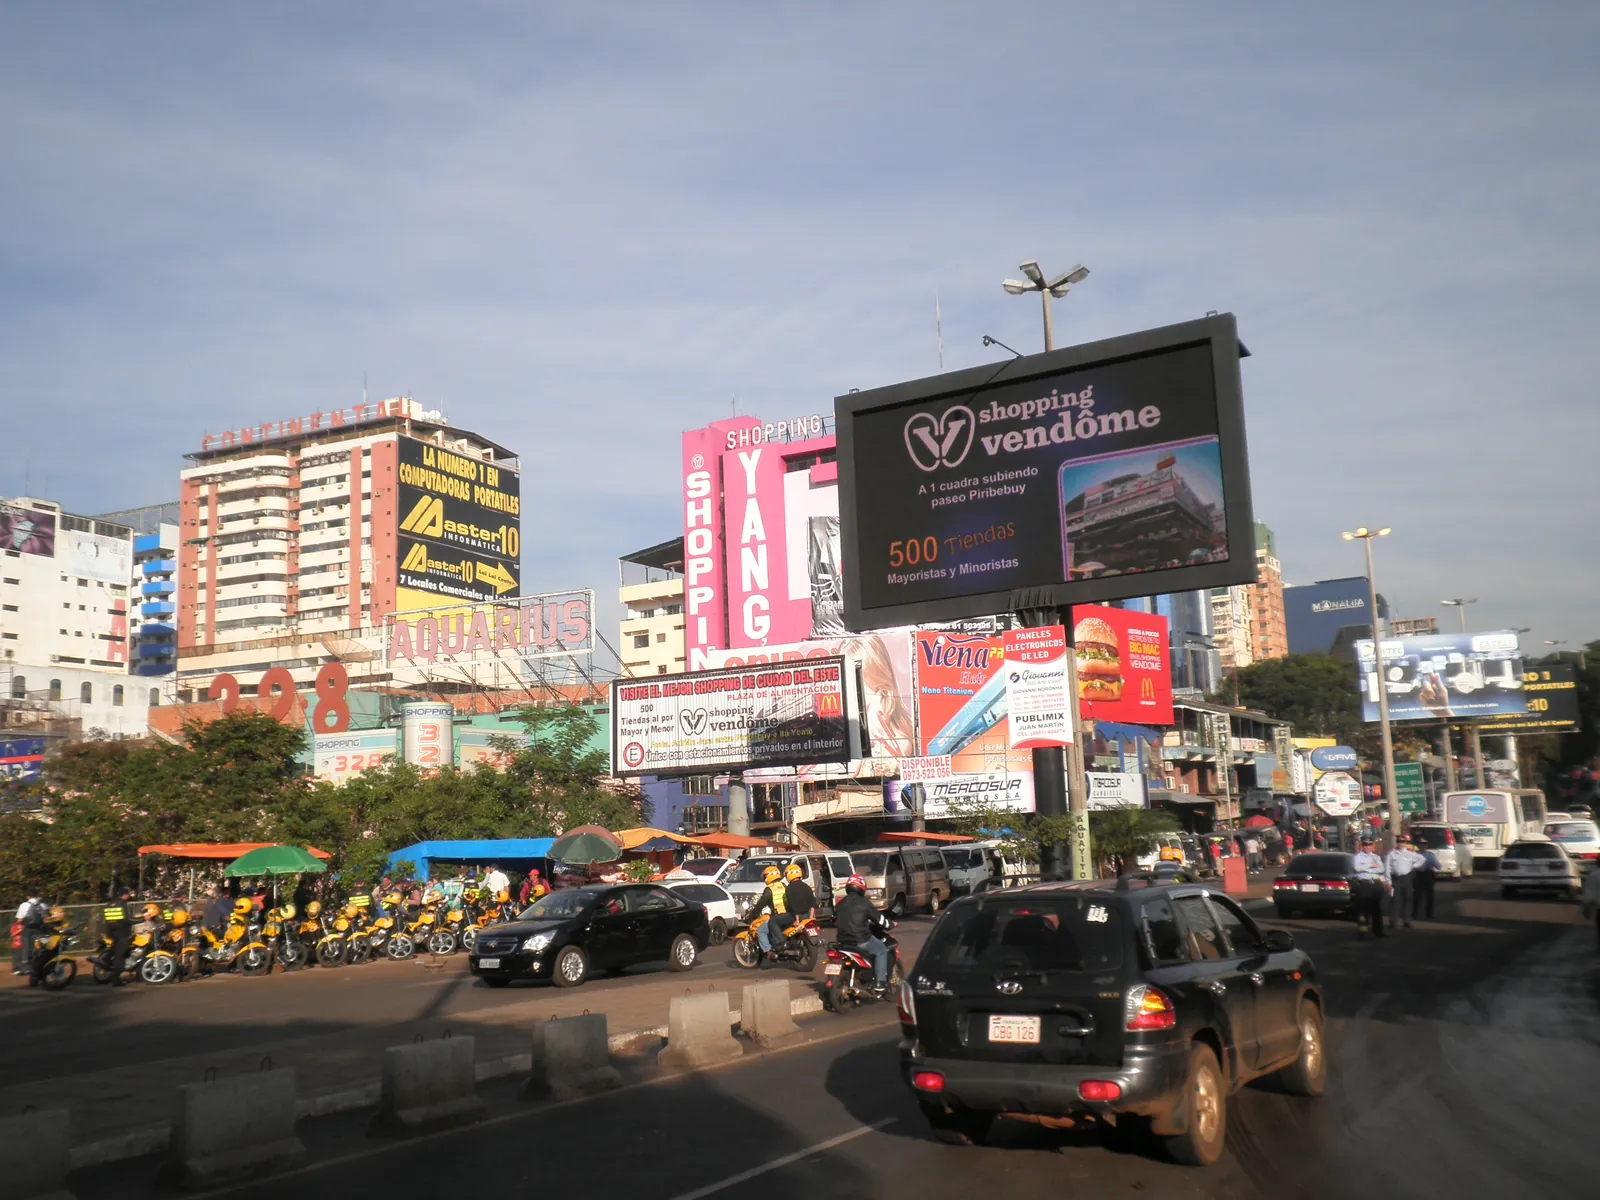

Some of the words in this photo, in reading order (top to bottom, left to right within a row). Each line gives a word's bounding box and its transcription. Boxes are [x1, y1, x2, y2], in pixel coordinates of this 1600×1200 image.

[979, 385, 1095, 424] shopping
[201, 397, 410, 451] CONTINENTAL
[727, 415, 821, 449] SHOPPING
[980, 404, 1162, 456] vendôme
[423, 445, 435, 468] LA
[438, 451, 477, 481] NUMERO
[479, 464, 485, 483] 1
[487, 466, 499, 488] EN
[918, 483, 928, 494] A
[930, 482, 936, 492] 1
[939, 475, 979, 493] cuadra
[982, 465, 1039, 488] subiendo
[400, 462, 470, 502] COMPUTADORAS
[474, 485, 519, 515] PORTATILES
[931, 492, 966, 509] paseo
[969, 482, 1026, 504] Piribebuy
[889, 536, 938, 568] 500
[944, 521, 1016, 555] Tiendas
[686, 471, 714, 671] SHOPPIN
[888, 567, 947, 585] Mayoristas
[950, 566, 956, 578] y
[959, 556, 1019, 573] Minoristas
[400, 574, 405, 584] 7
[407, 577, 437, 592] Locales
[439, 582, 483, 601] Comerciales
[388, 599, 588, 663] AQUARIUS
[1016, 630, 1051, 640] PANELES
[919, 635, 990, 670] Viena
[989, 647, 1004, 659] PR
[1005, 639, 1064, 652] ELECTRONICOS
[1129, 642, 1142, 654] BIG
[1143, 644, 1160, 656] MAC
[1033, 651, 1049, 659] LED
[1130, 660, 1162, 671] VENDOME
[620, 685, 649, 701] VISITE
[650, 685, 661, 698] EL
[663, 682, 694, 697] MEJOR
[694, 676, 741, 696] SHOPPING
[742, 675, 755, 690] DE
[756, 671, 792, 688] CIUDAD
[794, 669, 813, 685] DEL
[814, 666, 839, 683] ESTE
[1022, 669, 1065, 683] Giovanni
[922, 686, 941, 694] Nano
[943, 686, 974, 695] Titanium
[1523, 681, 1575, 691] PORTATILES
[727, 692, 754, 701] PLAZA
[640, 703, 654, 713] 500
[709, 704, 754, 718] shopping
[621, 716, 650, 725] Tiendas
[652, 714, 659, 722] al
[661, 714, 673, 724] por
[710, 715, 779, 732] vendôme
[1015, 712, 1064, 723] PUBLIMIX
[620, 727, 643, 737] Mayor
[645, 727, 649, 736] y
[651, 725, 674, 734] Menor
[316, 738, 360, 750] SHOPPING
[645, 748, 667, 762] Único
[669, 751, 683, 760] con
[685, 745, 753, 759] estacionamientos
[755, 743, 789, 755] privados
[791, 742, 801, 750] en
[804, 740, 811, 749] el
[813, 738, 843, 749] interior
[335, 753, 382, 772] 328
[902, 756, 950, 769] DISPONIBLE
[903, 768, 935, 781] 0973-522
[937, 767, 950, 778] 056
[933, 779, 1022, 795] MERCOSUR
[1078, 815, 1087, 879] AGUAYITO
[1017, 1026, 1034, 1040] 126
